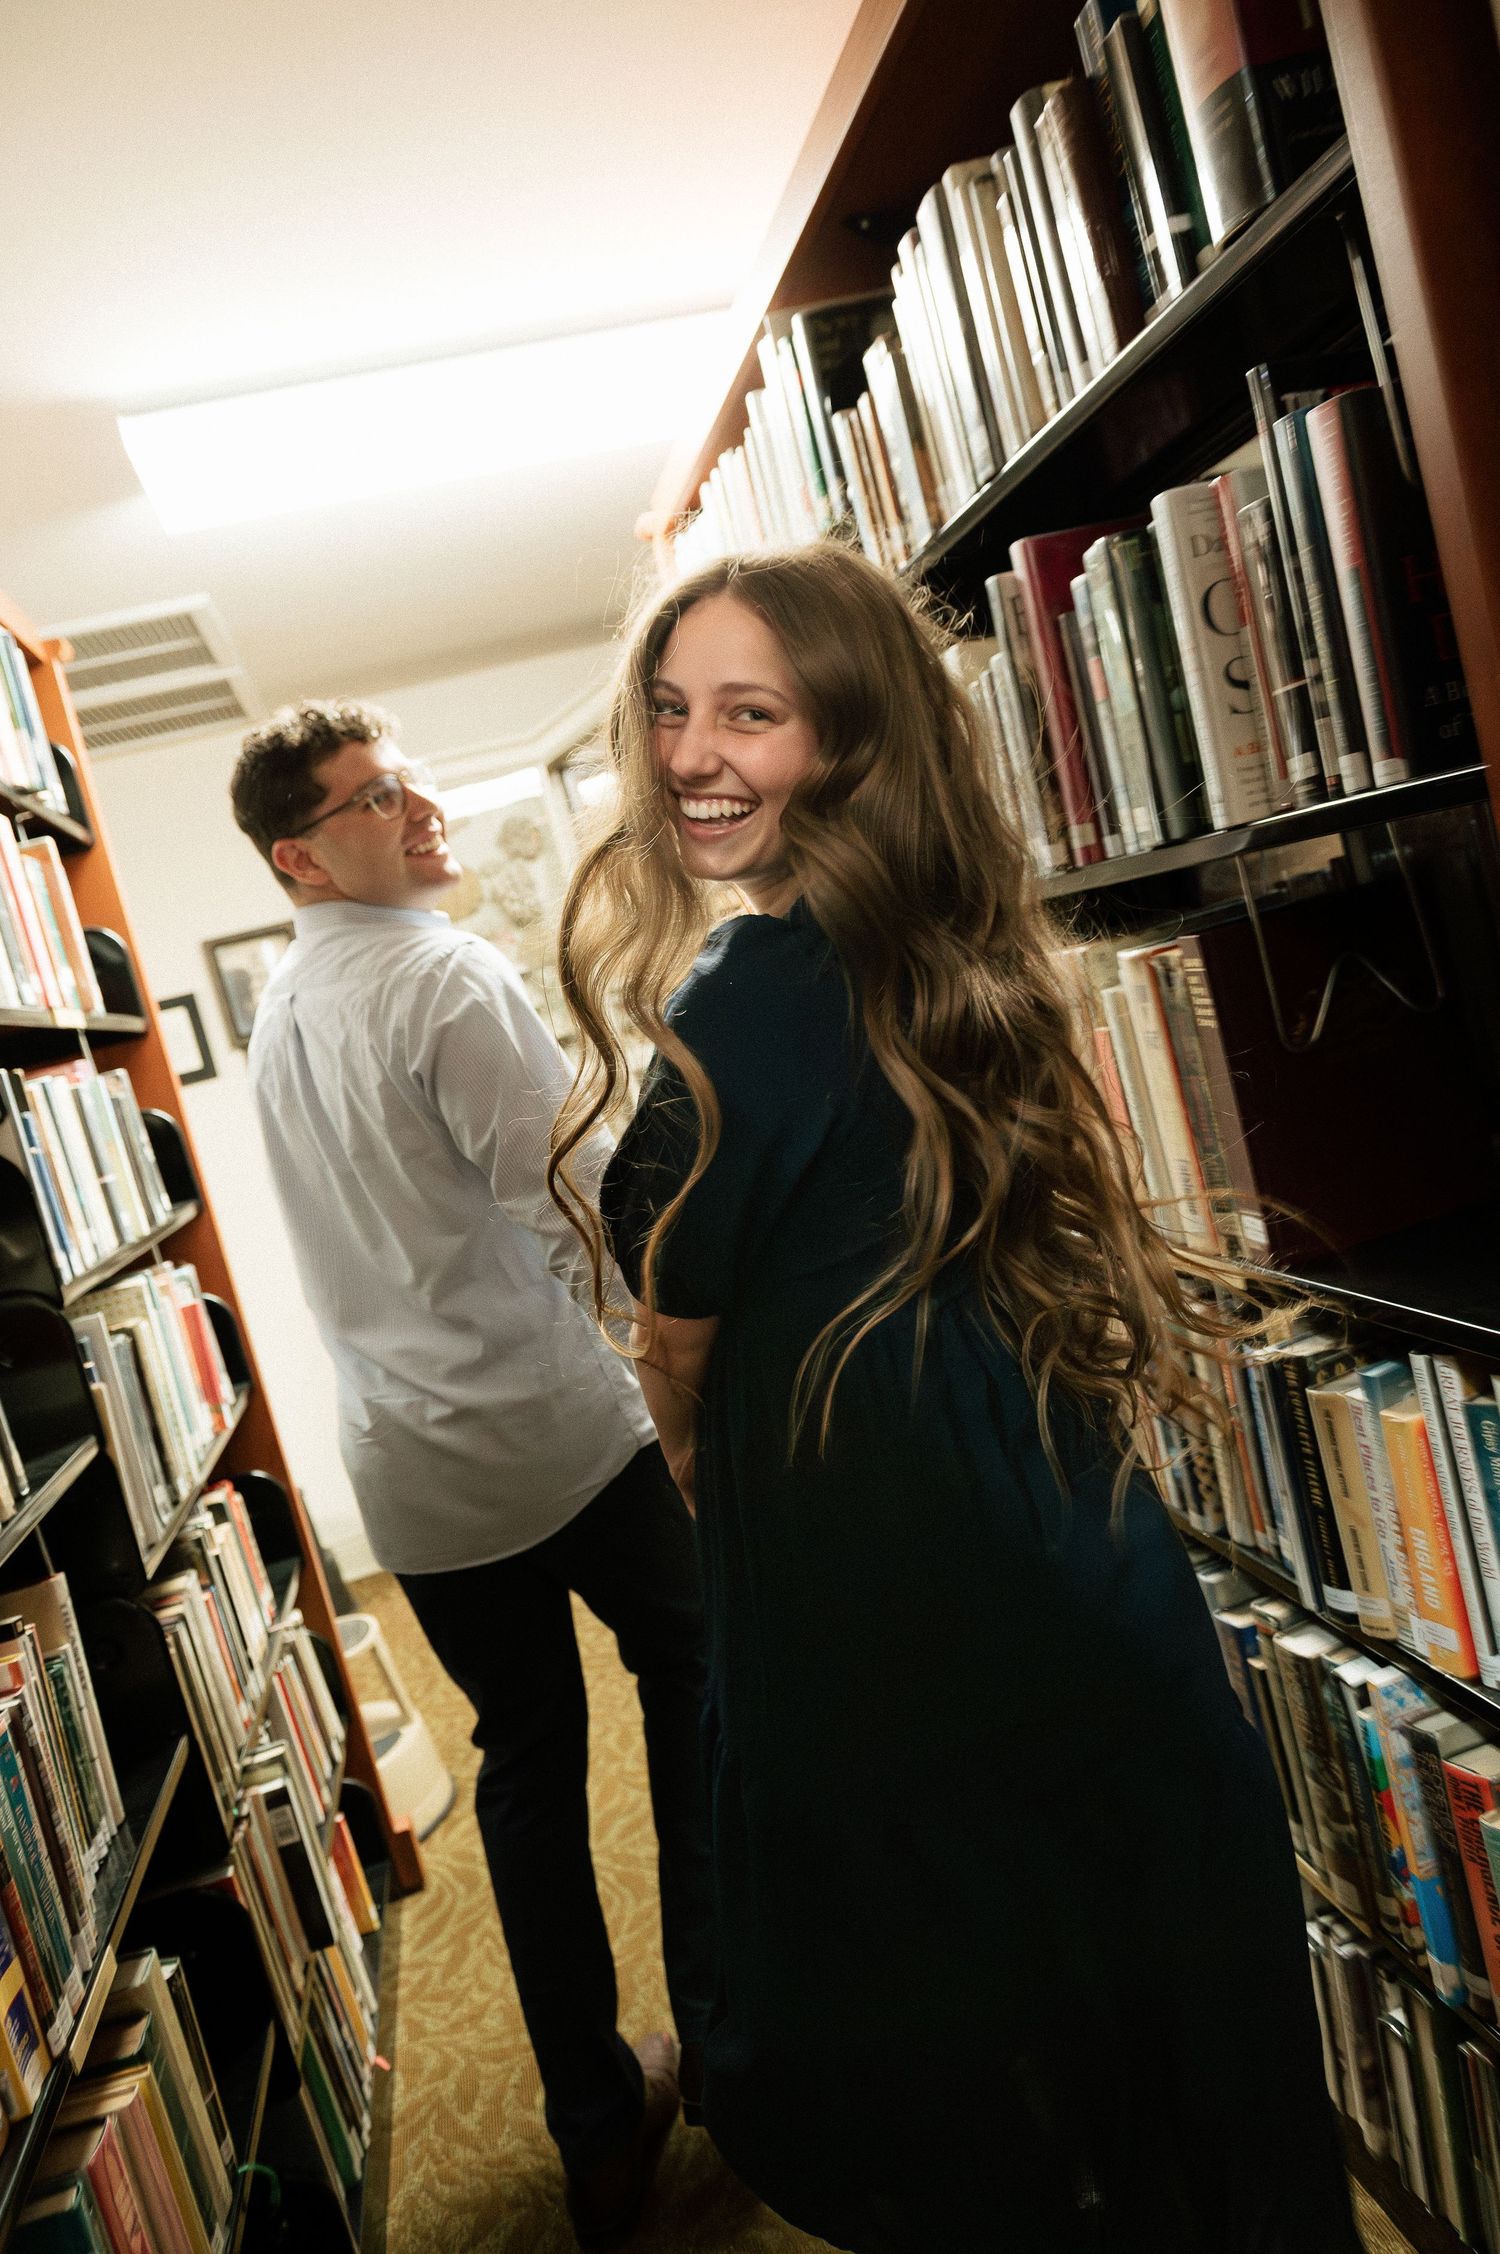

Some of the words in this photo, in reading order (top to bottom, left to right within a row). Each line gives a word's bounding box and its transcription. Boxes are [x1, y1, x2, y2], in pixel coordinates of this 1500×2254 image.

[1439, 1363, 1463, 1412] GREAT
[1448, 1416, 1479, 1495] JOURNEYS
[1408, 1525, 1442, 1611] ENGLAND
[1477, 1541, 1497, 1580] World
